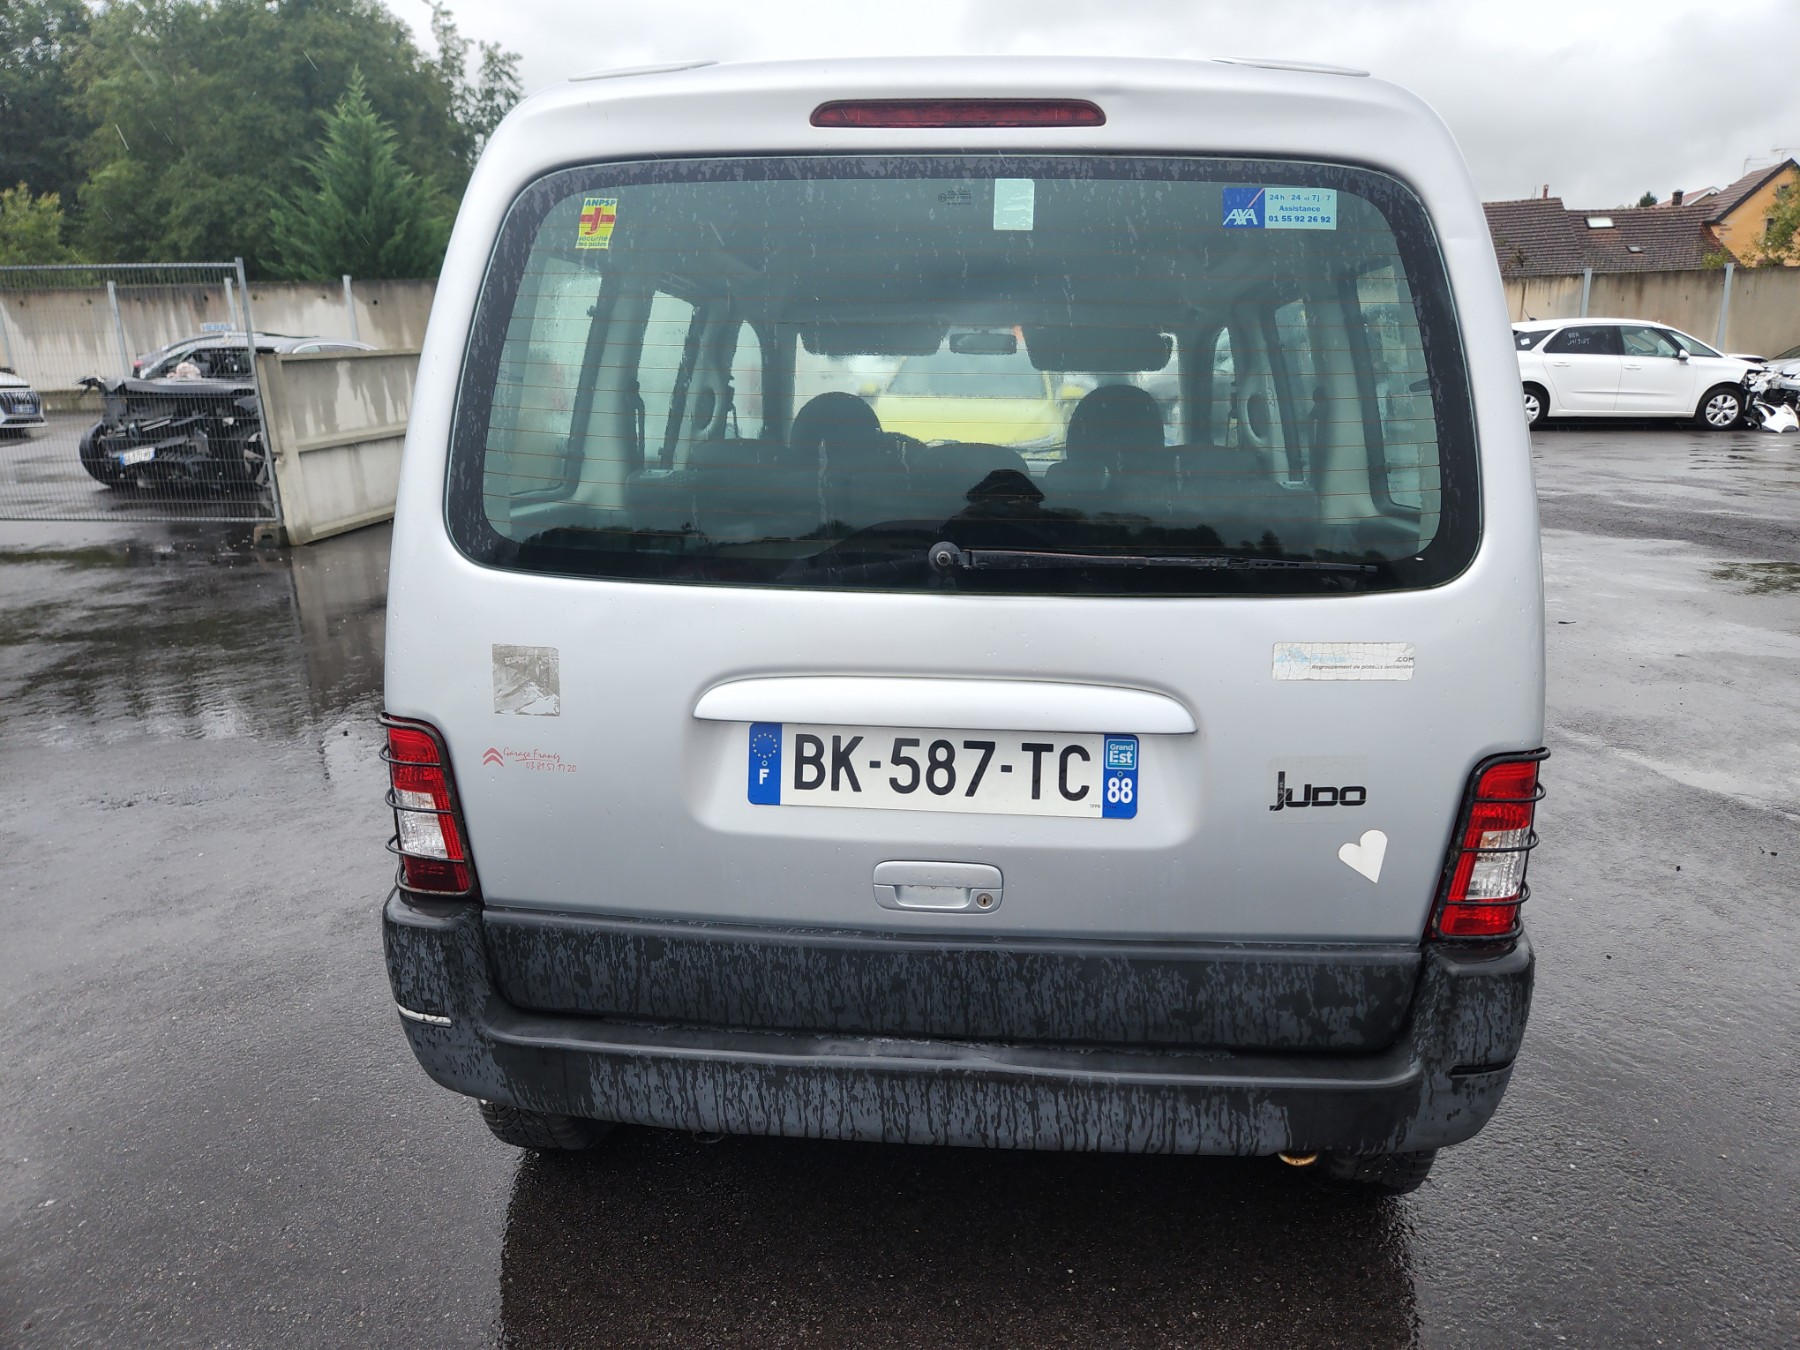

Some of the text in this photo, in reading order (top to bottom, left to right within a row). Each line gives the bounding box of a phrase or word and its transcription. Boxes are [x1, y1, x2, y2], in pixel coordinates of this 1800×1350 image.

[1223, 208, 1258, 225] AXA
[1109, 751, 1133, 763] Est
[793, 733, 1091, 801] BK-587-TC
[759, 768, 770, 785] F
[1107, 777, 1133, 803] 88
